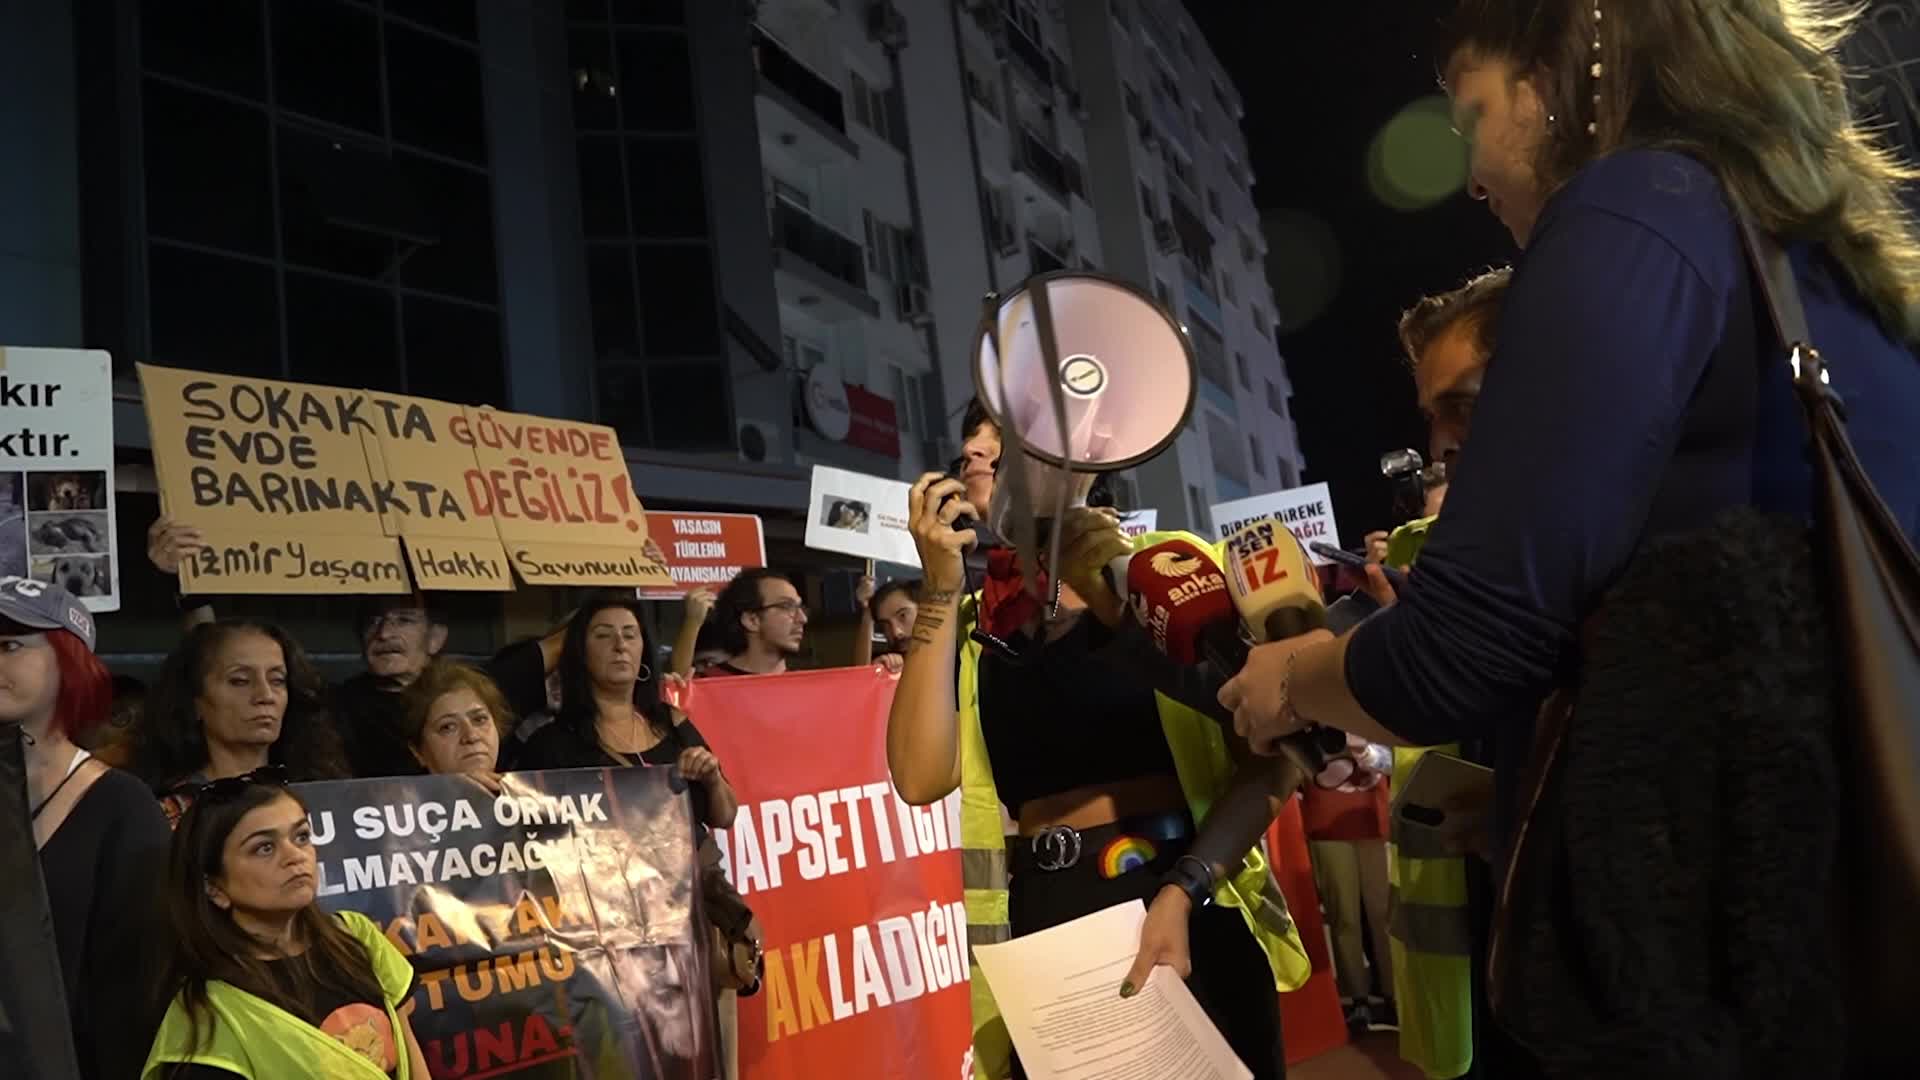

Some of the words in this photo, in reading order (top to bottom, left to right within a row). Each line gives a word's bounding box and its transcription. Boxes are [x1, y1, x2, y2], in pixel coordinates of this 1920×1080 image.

[182, 381, 437, 443] SOKAKTA
[448, 409, 613, 461] GÜVENDE
[185, 426, 317, 470] EVDE
[190, 466, 466, 522] BARINAKTA
[463, 457, 639, 533] DEĞİLİZ!
[1294, 520, 1327, 540] AĞIZ
[416, 548, 500, 580] Hakkı
[673, 539, 726, 559] TÜRLERİN
[668, 566, 742, 584] AYANIŞMAS
[1167, 573, 1224, 602] anka
[307, 810, 336, 846] U
[352, 799, 483, 844] SUÇA
[493, 793, 608, 828] ORTAK
